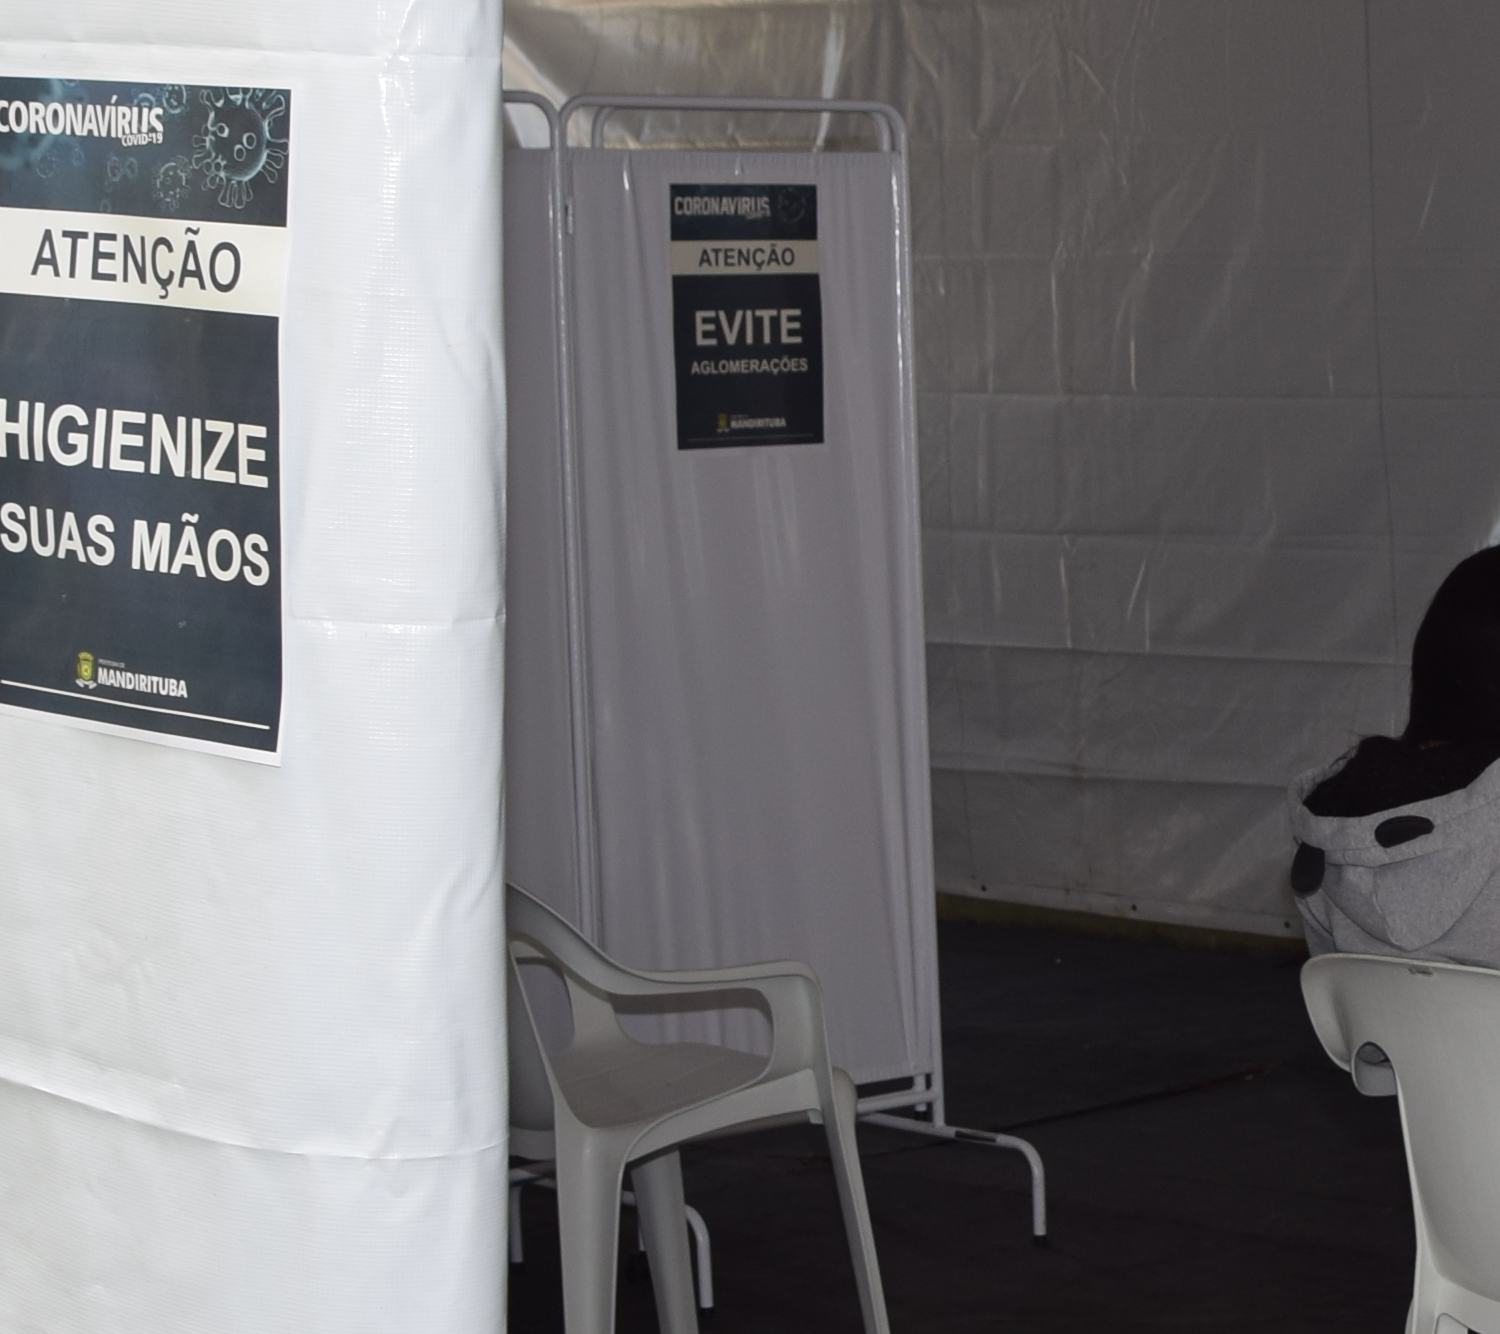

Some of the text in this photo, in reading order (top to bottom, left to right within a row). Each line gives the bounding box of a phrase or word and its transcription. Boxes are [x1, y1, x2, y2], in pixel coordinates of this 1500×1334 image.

[30, 227, 242, 299] ATENÇÃO
[698, 244, 796, 271] ATENÇÃO
[695, 309, 803, 346] EVITE
[691, 357, 809, 376] AGLOMERAÇÕES
[0, 502, 270, 586] SUAS MÃOS
[98, 667, 188, 698] MANDIRITUBA
